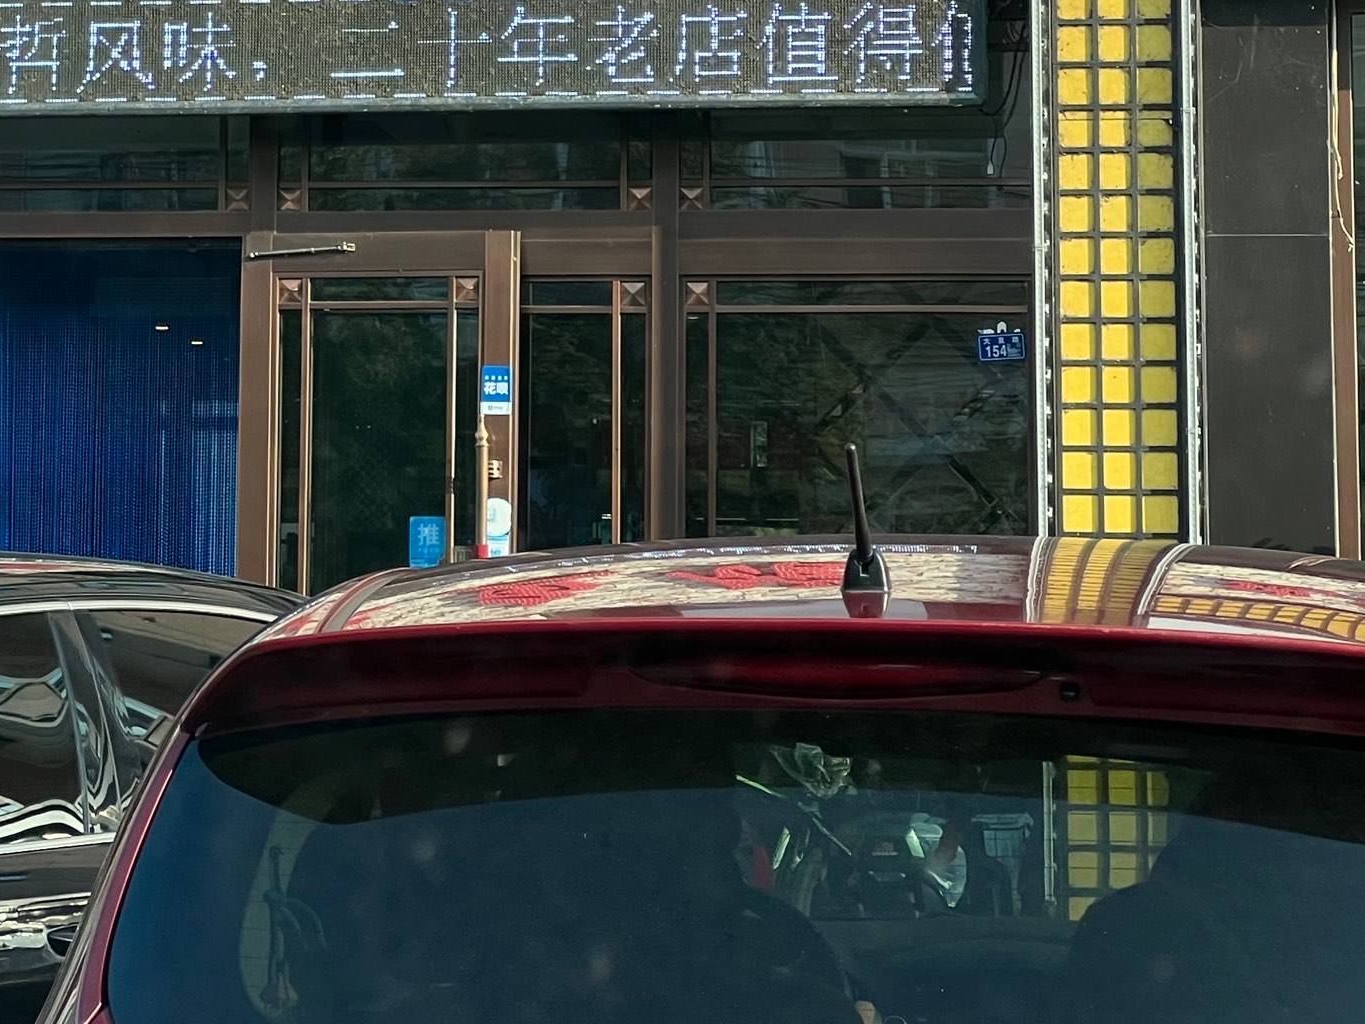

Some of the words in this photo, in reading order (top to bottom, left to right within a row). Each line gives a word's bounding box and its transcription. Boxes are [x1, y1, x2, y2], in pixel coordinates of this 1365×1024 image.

[985, 345, 1007, 358] 154
[483, 381, 509, 395] 花呗
[417, 522, 440, 546] 推
